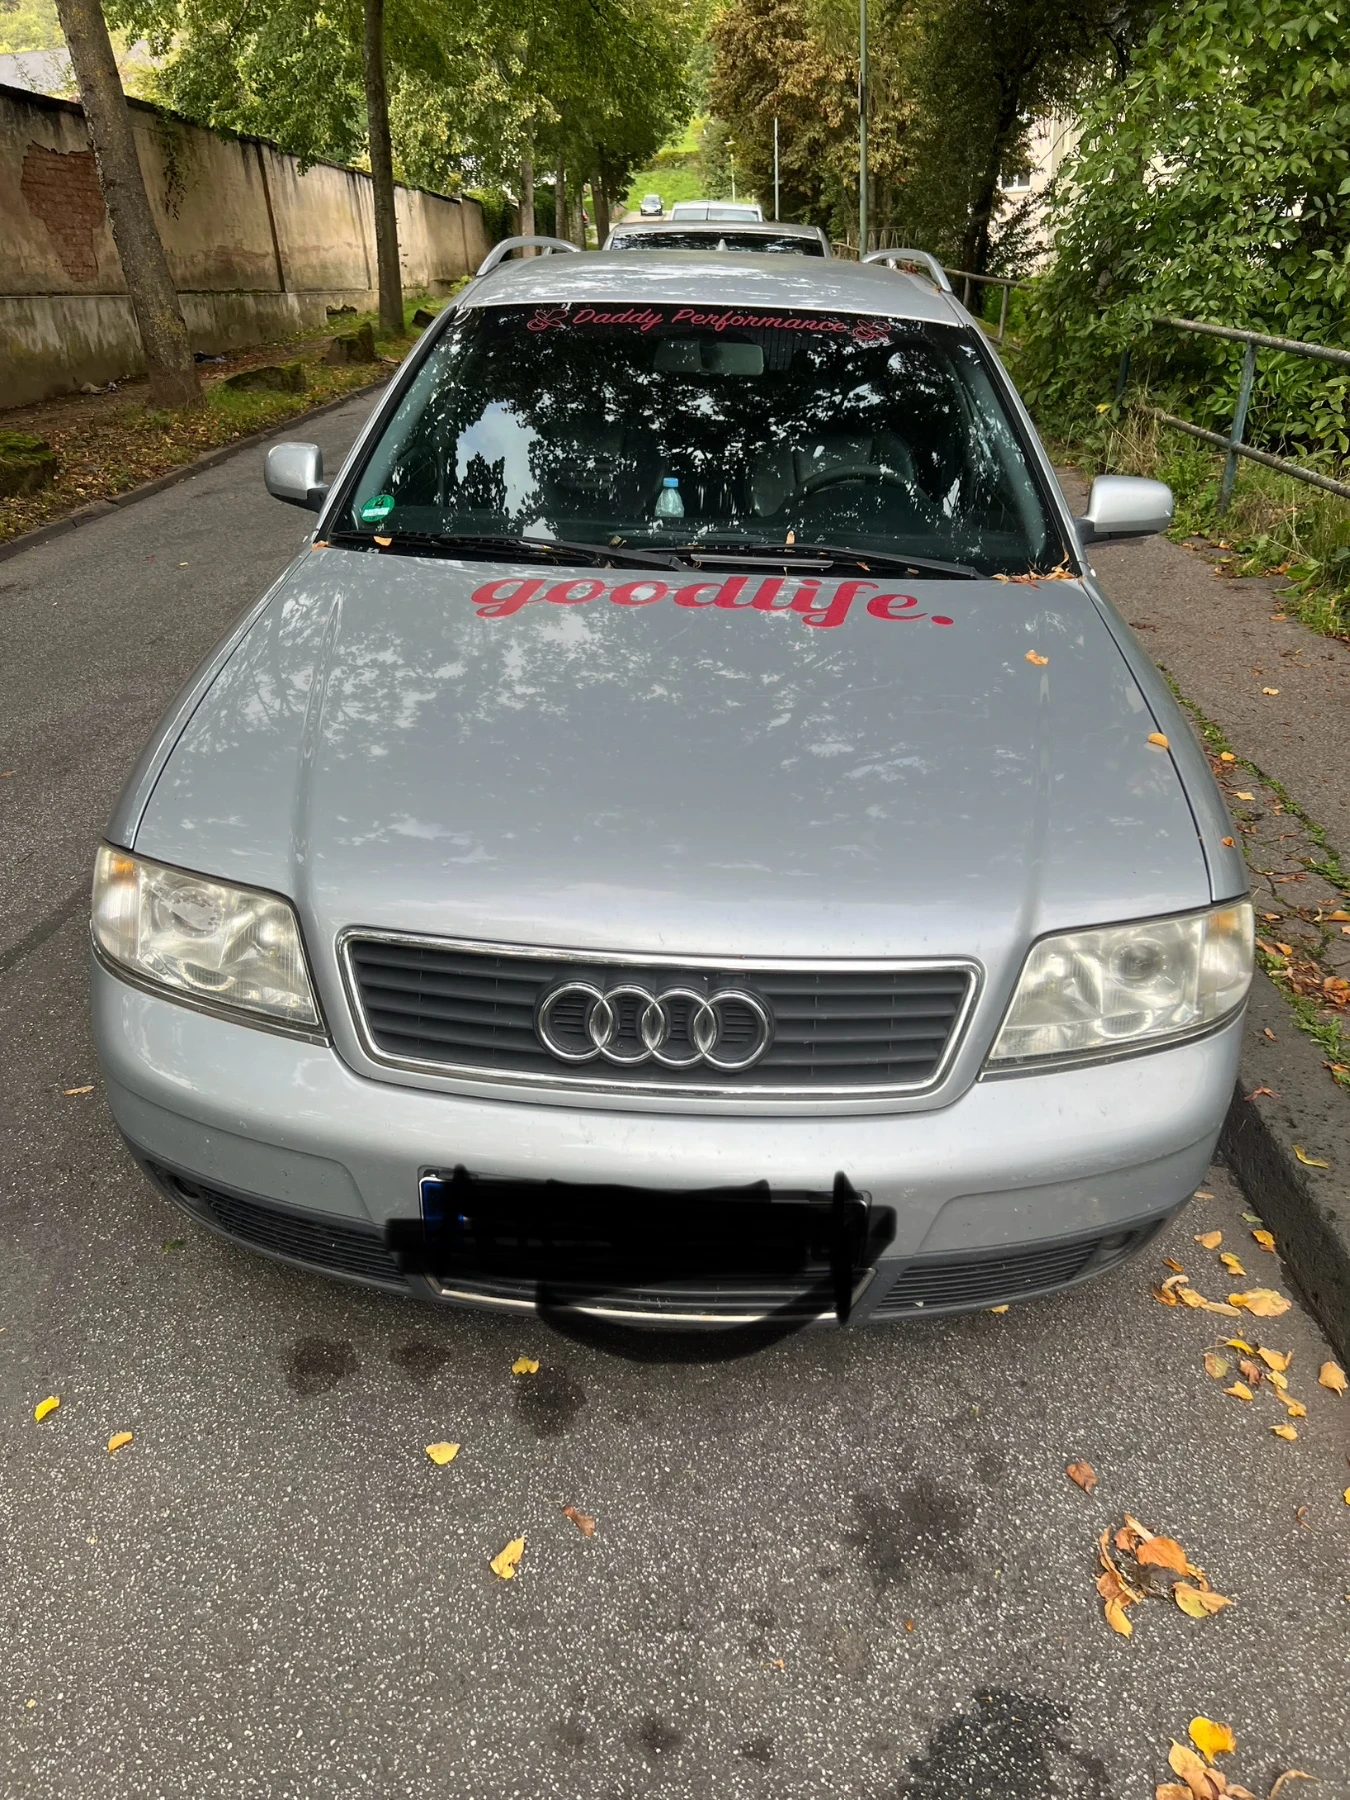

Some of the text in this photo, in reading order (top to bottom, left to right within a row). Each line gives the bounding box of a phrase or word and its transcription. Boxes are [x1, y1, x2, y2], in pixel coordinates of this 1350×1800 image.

[572, 308, 848, 333] Daddy Performance
[374, 495, 385, 508] 4
[470, 576, 955, 628] goodlife.
